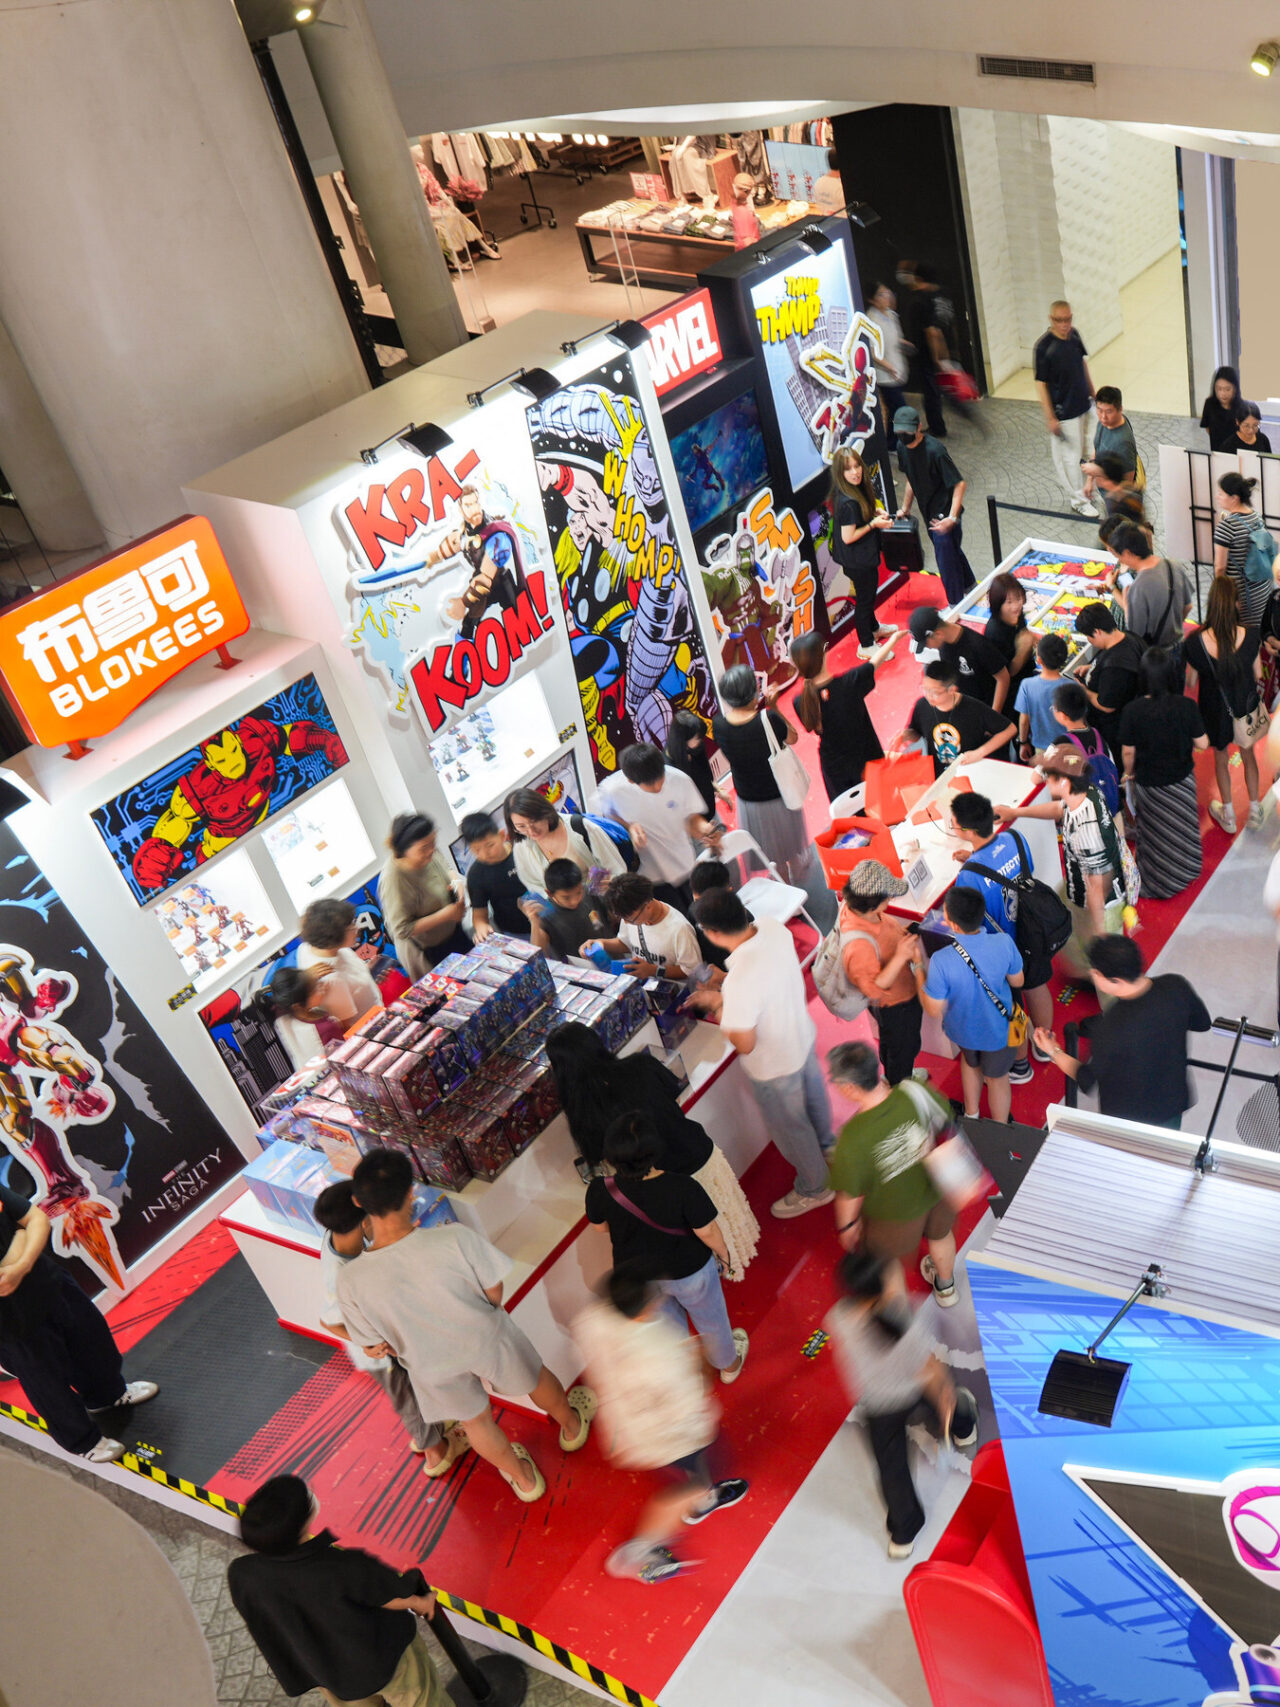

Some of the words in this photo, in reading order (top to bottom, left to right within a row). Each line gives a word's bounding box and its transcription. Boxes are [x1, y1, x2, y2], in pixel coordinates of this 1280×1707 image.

[756, 294, 821, 344] THWIP
[785, 276, 819, 297] THWIP
[345, 449, 480, 570] KRA-
[603, 451, 681, 590] WHOMP!
[749, 492, 815, 639] SMSH
[16, 539, 210, 683] 布鲁可
[49, 600, 224, 718] BLOKEES
[410, 570, 555, 733] KOOM!
[141, 1147, 222, 1223] INFINITY
[171, 1178, 209, 1212] SAGA
